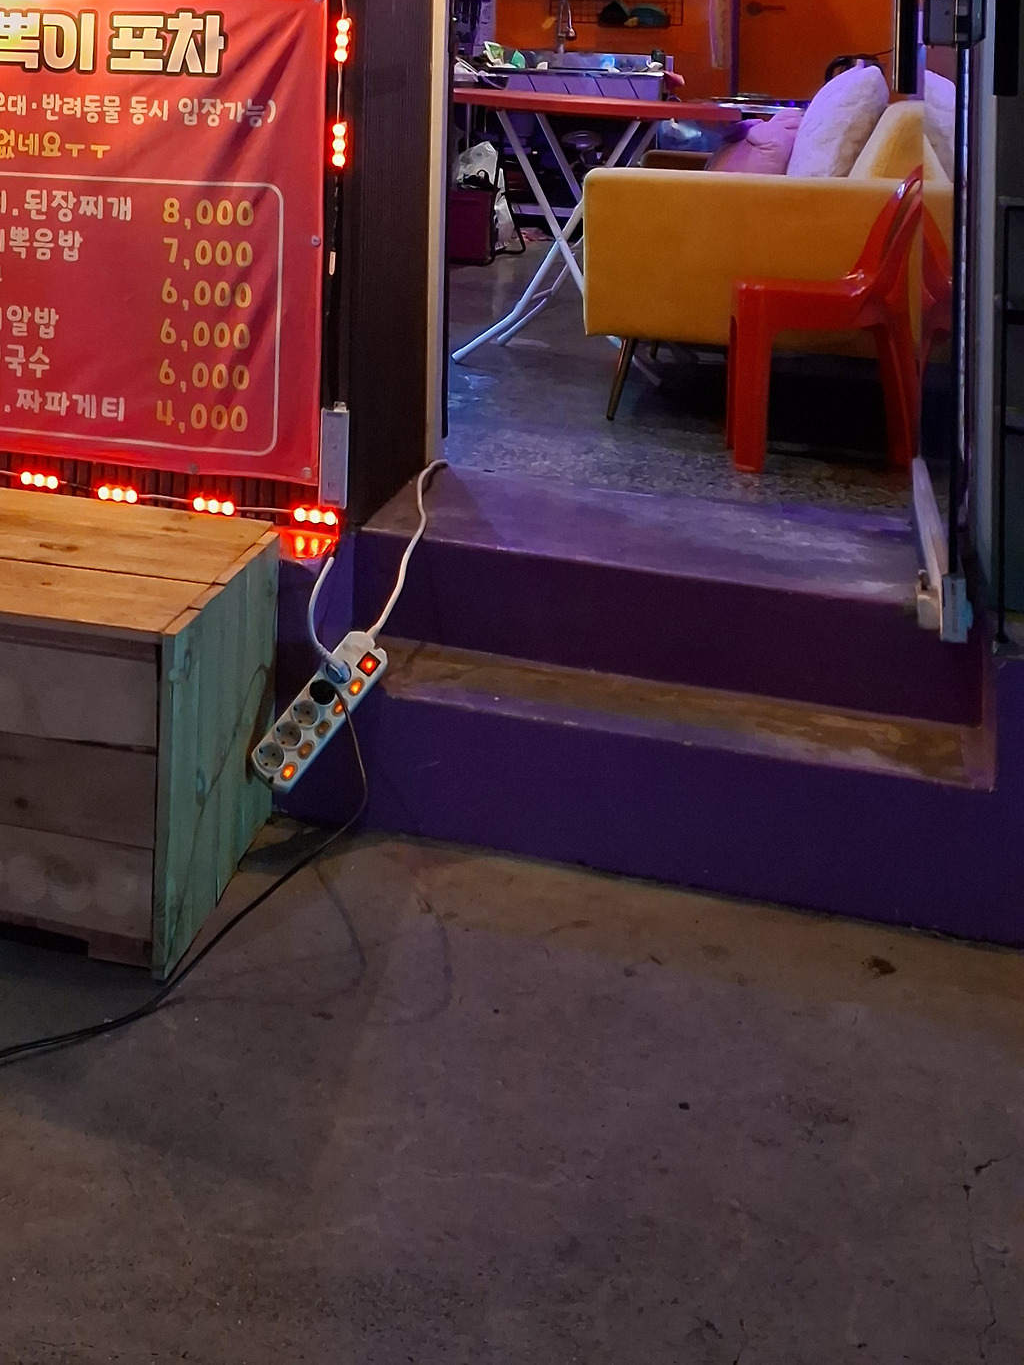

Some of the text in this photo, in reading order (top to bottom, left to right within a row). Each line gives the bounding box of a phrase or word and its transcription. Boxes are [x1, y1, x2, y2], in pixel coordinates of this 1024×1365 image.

[108, 13, 226, 75] 포차
[129, 95, 169, 125] 동시
[178, 98, 276, 128] 입장가능)
[162, 197, 255, 231] 8,000
[162, 237, 254, 272] 7,000
[160, 278, 253, 312] 6,000
[159, 317, 251, 353] 6,000
[158, 358, 251, 393] 6,000
[155, 399, 249, 435] 4,000
